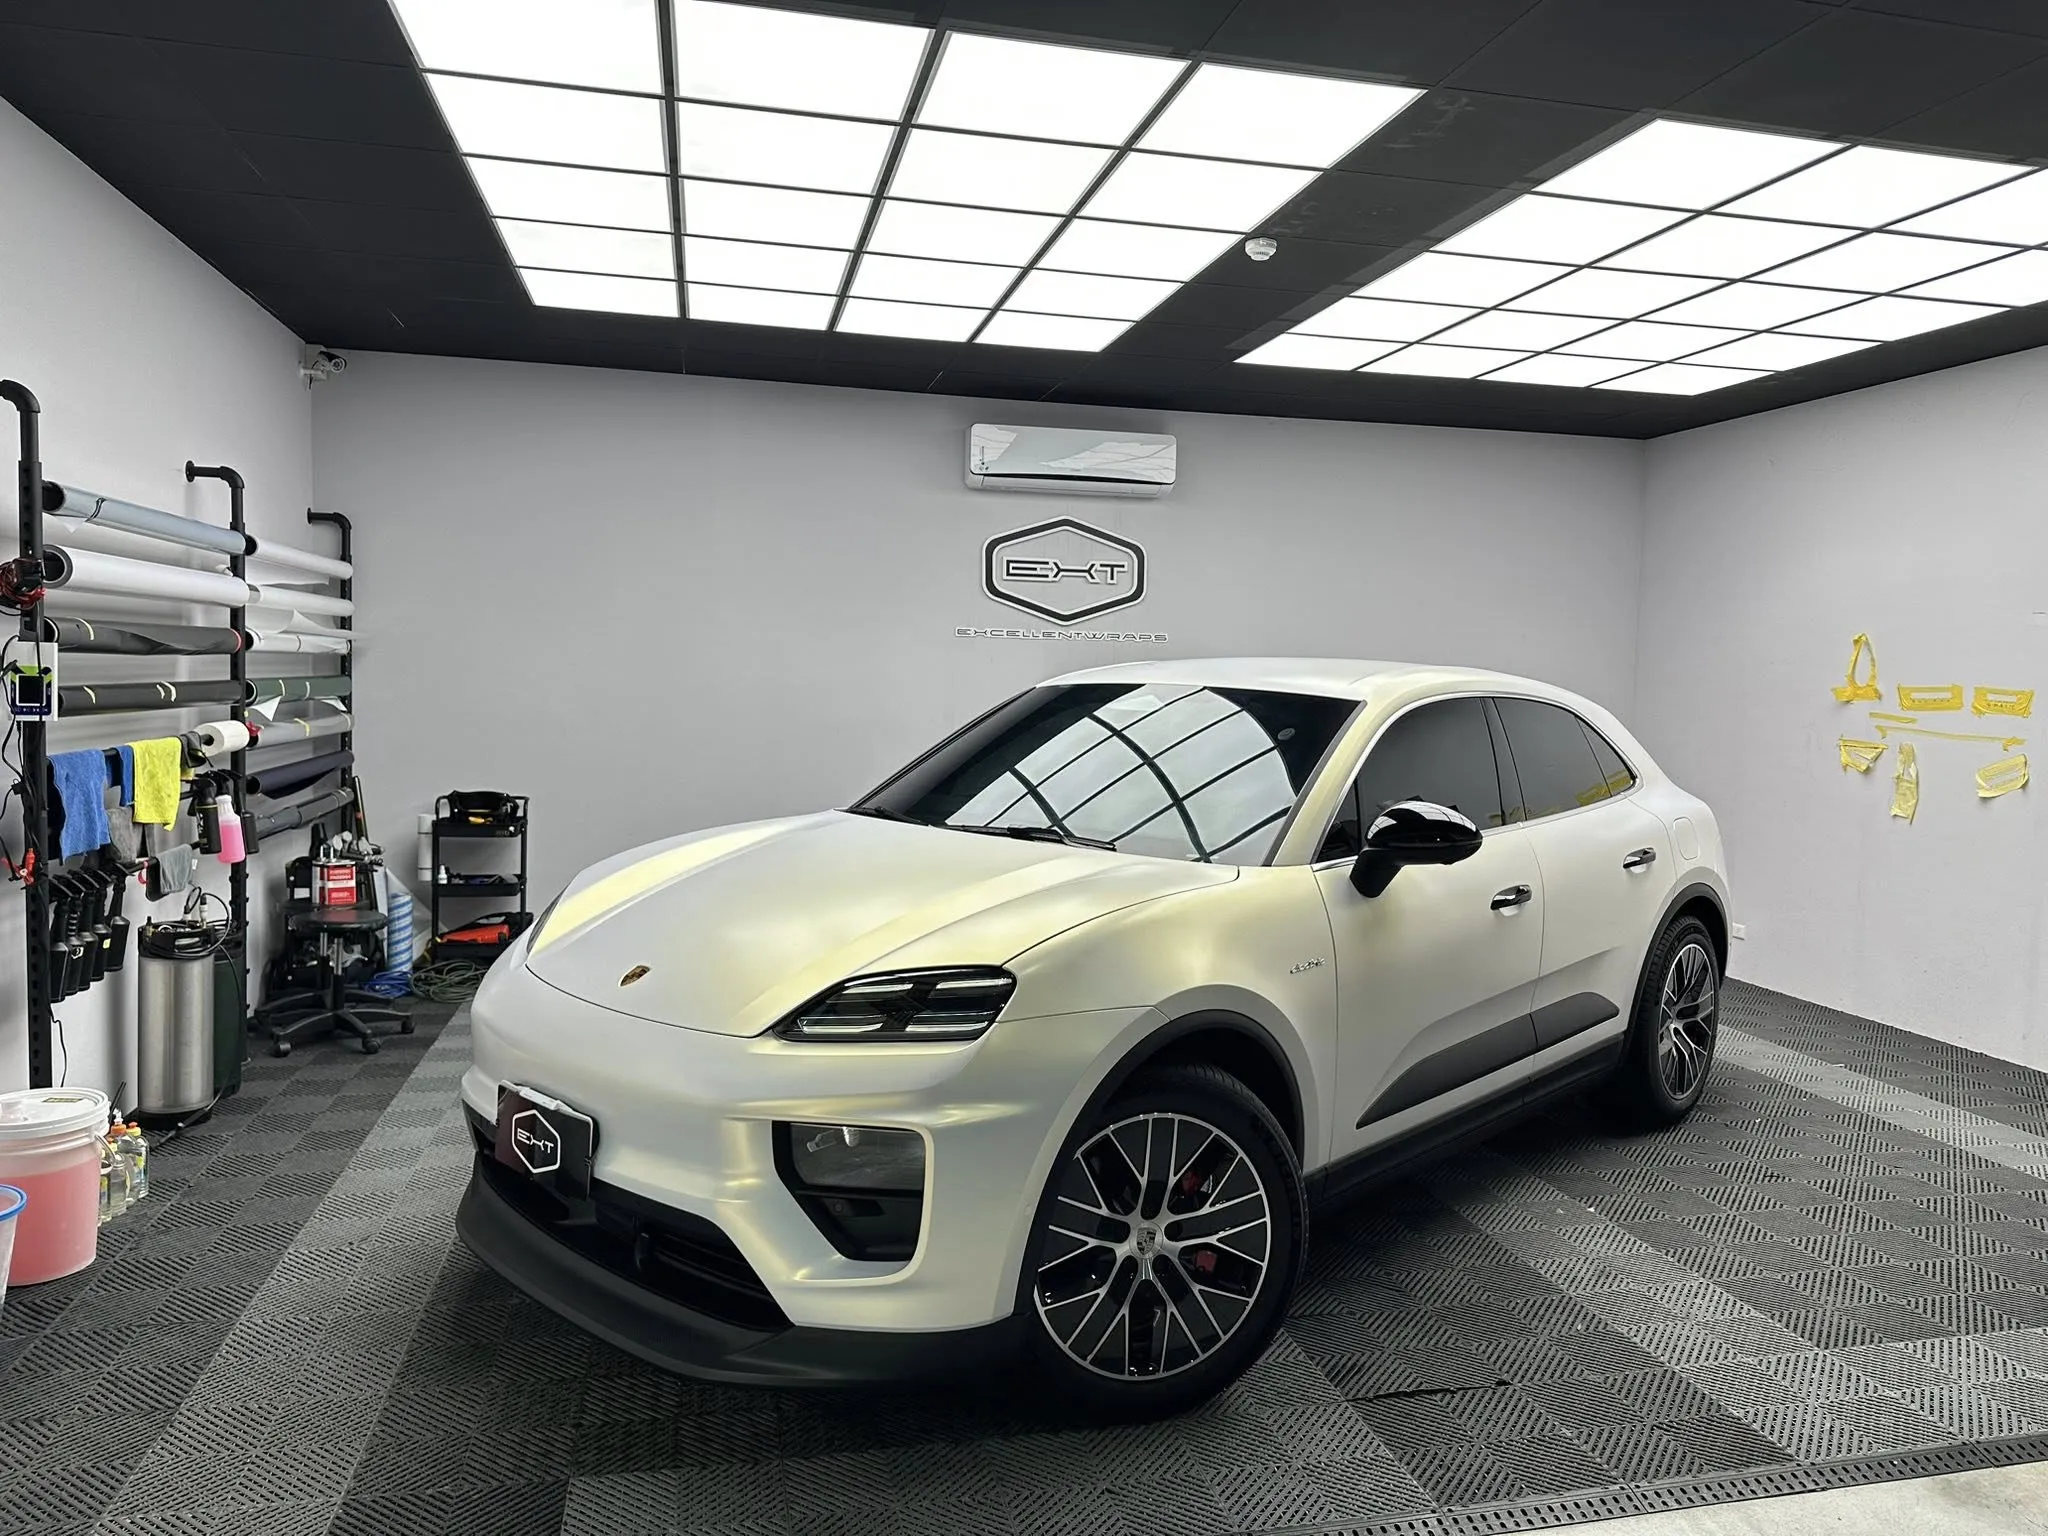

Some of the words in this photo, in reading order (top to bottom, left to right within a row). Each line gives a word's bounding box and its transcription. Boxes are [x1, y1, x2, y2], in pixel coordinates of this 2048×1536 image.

[1003, 557, 1128, 584] EXT
[956, 627, 1168, 643] EXCELLENTWRAPS
[516, 1127, 555, 1154] EXT
